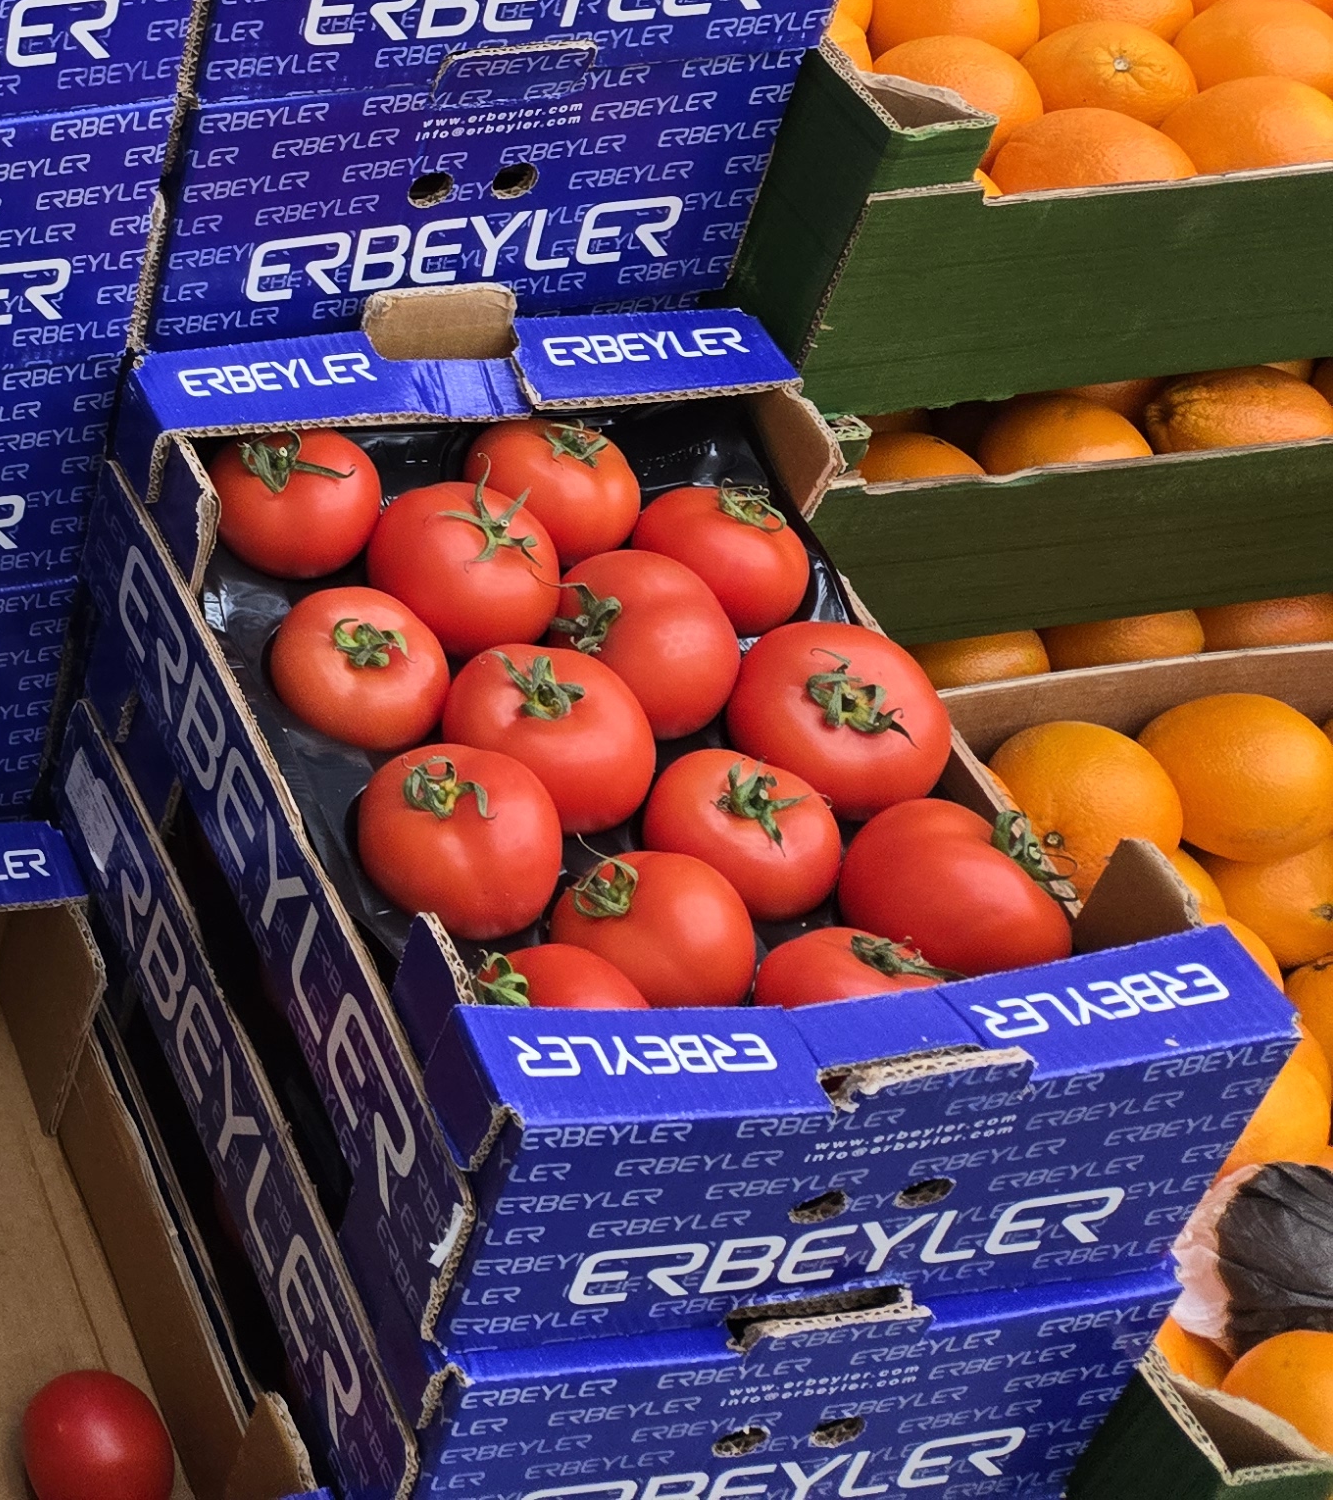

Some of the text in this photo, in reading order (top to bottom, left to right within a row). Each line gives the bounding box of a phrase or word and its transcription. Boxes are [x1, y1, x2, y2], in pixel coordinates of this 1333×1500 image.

[415, 115, 580, 141] info@erbeyler.com
[423, 102, 582, 128] www.erbeyler.com
[272, 128, 400, 159] ERBEYLER
[183, 171, 310, 203] ERBEYLER
[568, 161, 694, 189] ERBEYLER
[255, 195, 379, 226] ERBEYLER
[246, 196, 682, 302] ERBEYLER
[543, 328, 749, 366] ERBEYLER
[178, 353, 377, 396] ERBEYLER
[115, 545, 417, 1218] ERBEYLER
[971, 964, 1229, 1038] ERBEYLER
[509, 1034, 777, 1076] ERBEYLER
[521, 1124, 692, 1150] ERBEYLER
[804, 1127, 1013, 1163] info@erbeyler.com
[815, 1115, 1017, 1150] www.erbeyler.com
[615, 1150, 783, 1176] ERBEYLER
[495, 1188, 663, 1215] ERBEYLER
[587, 1210, 751, 1238] ERBEYLER
[569, 1188, 1124, 1305] ERBEYLER
